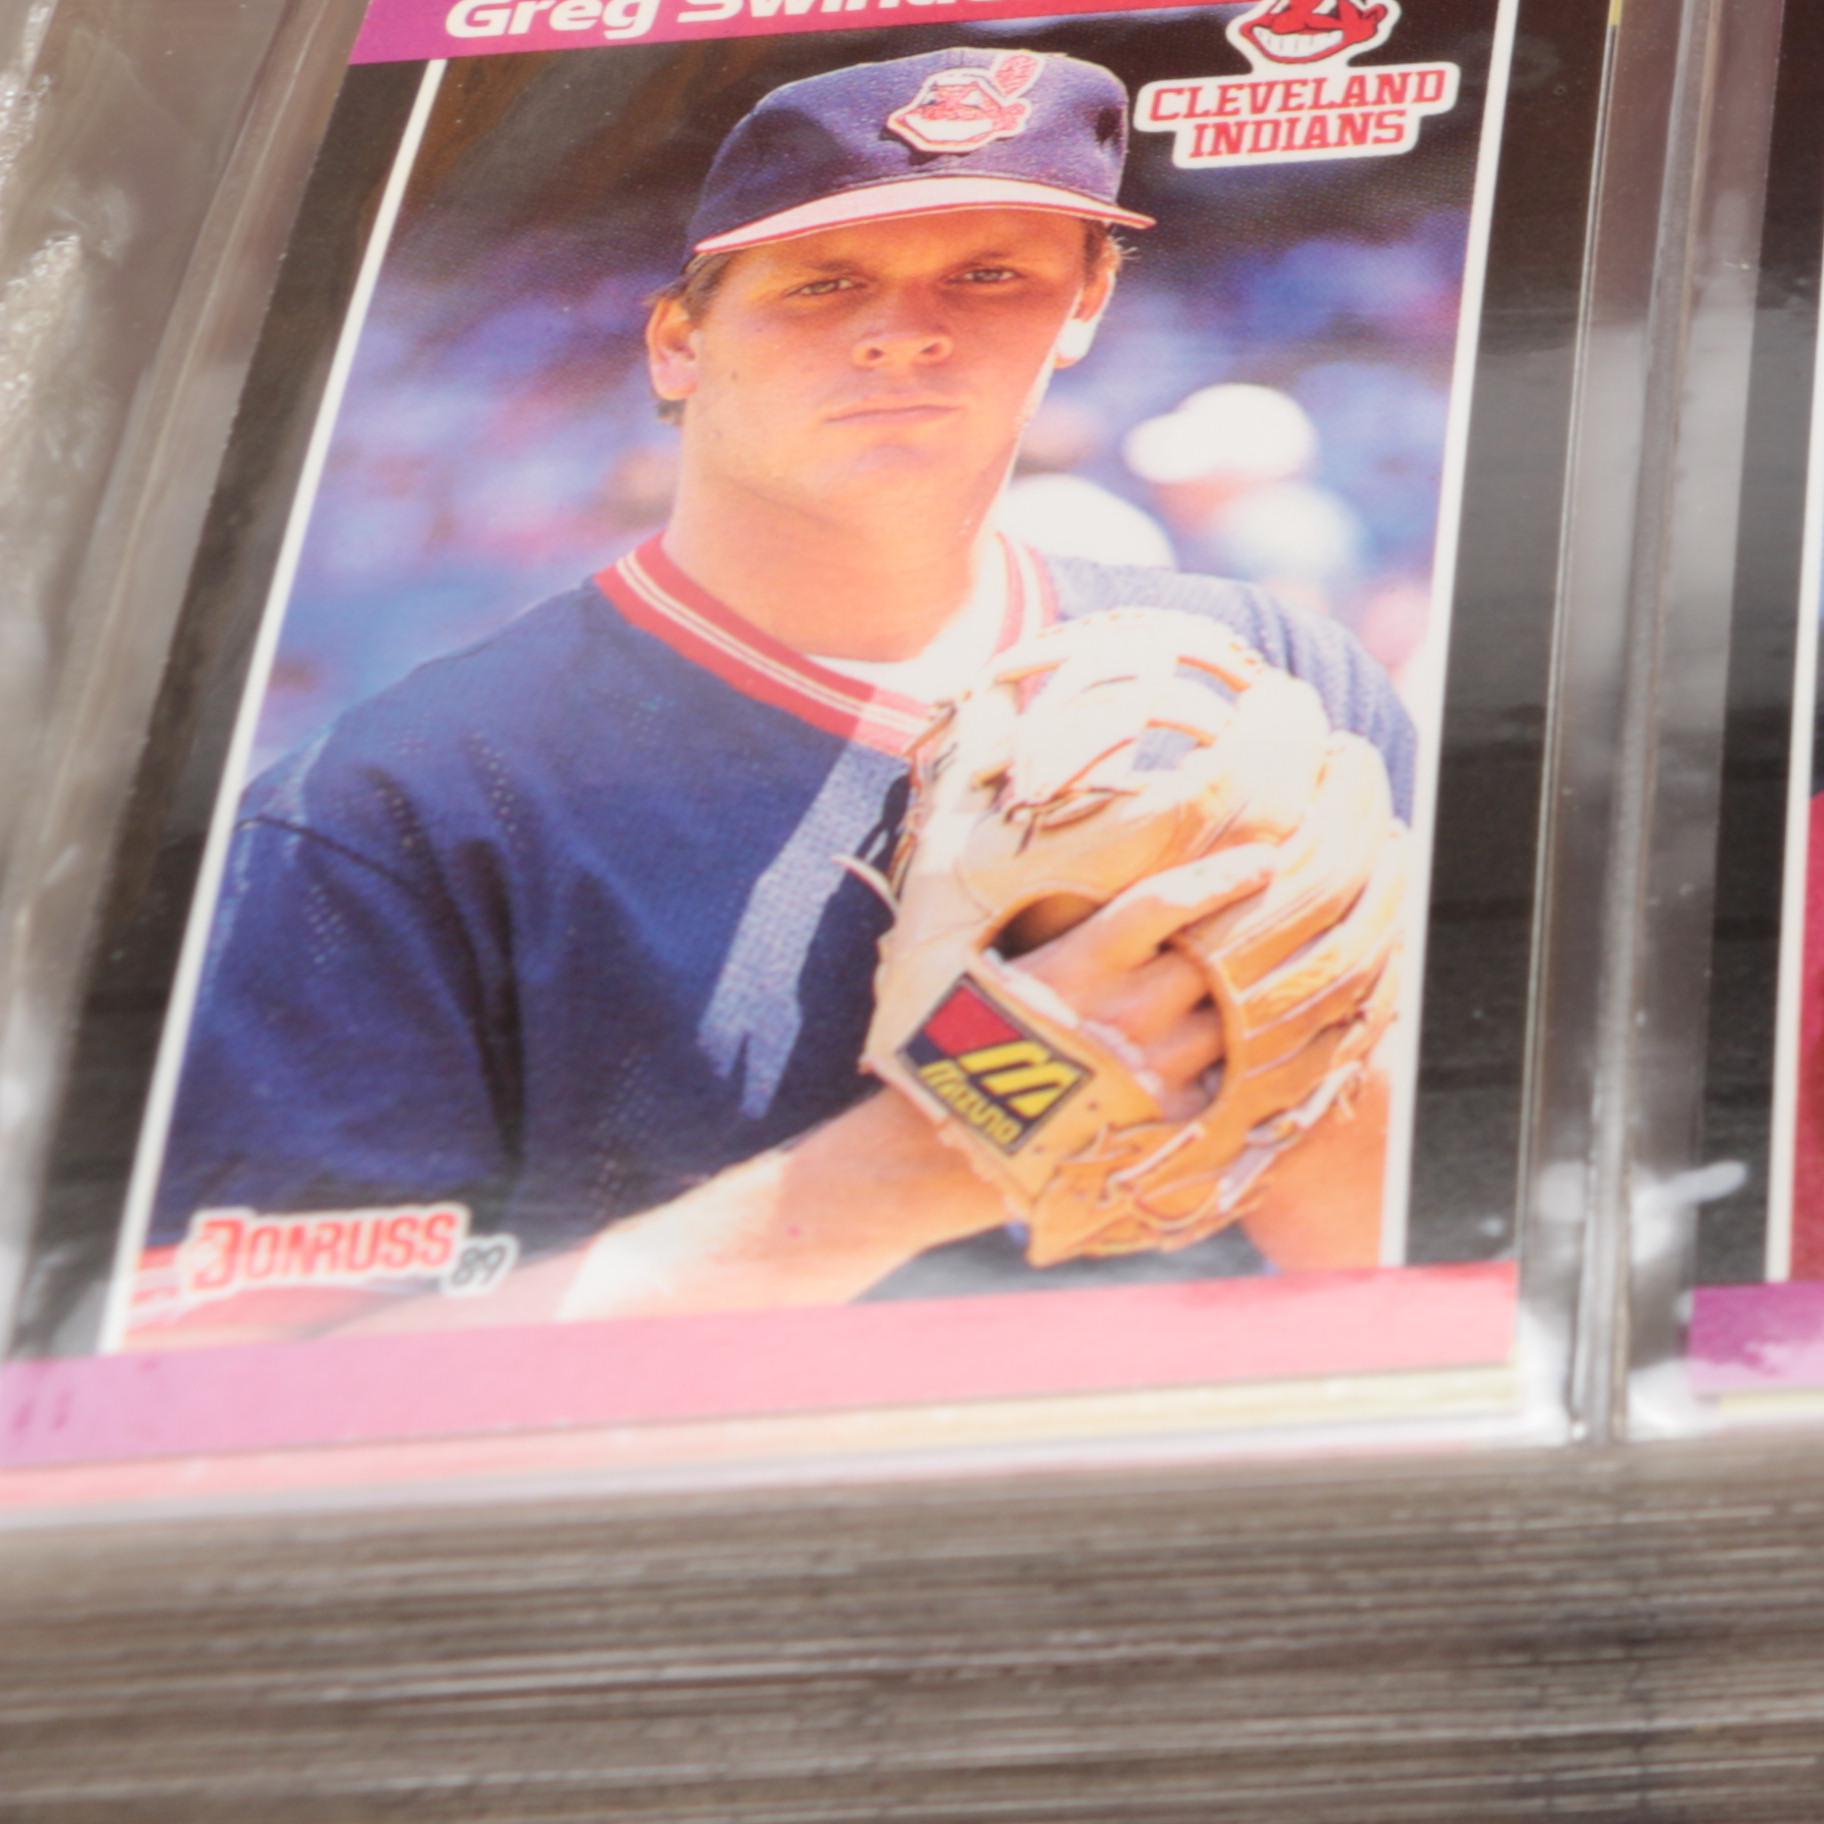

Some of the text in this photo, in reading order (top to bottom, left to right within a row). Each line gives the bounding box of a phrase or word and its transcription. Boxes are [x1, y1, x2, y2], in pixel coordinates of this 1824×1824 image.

[1149, 71, 1448, 121] CLEVELAND
[1188, 110, 1408, 159] INDIANS
[190, 1212, 457, 1292] DONRUSS
